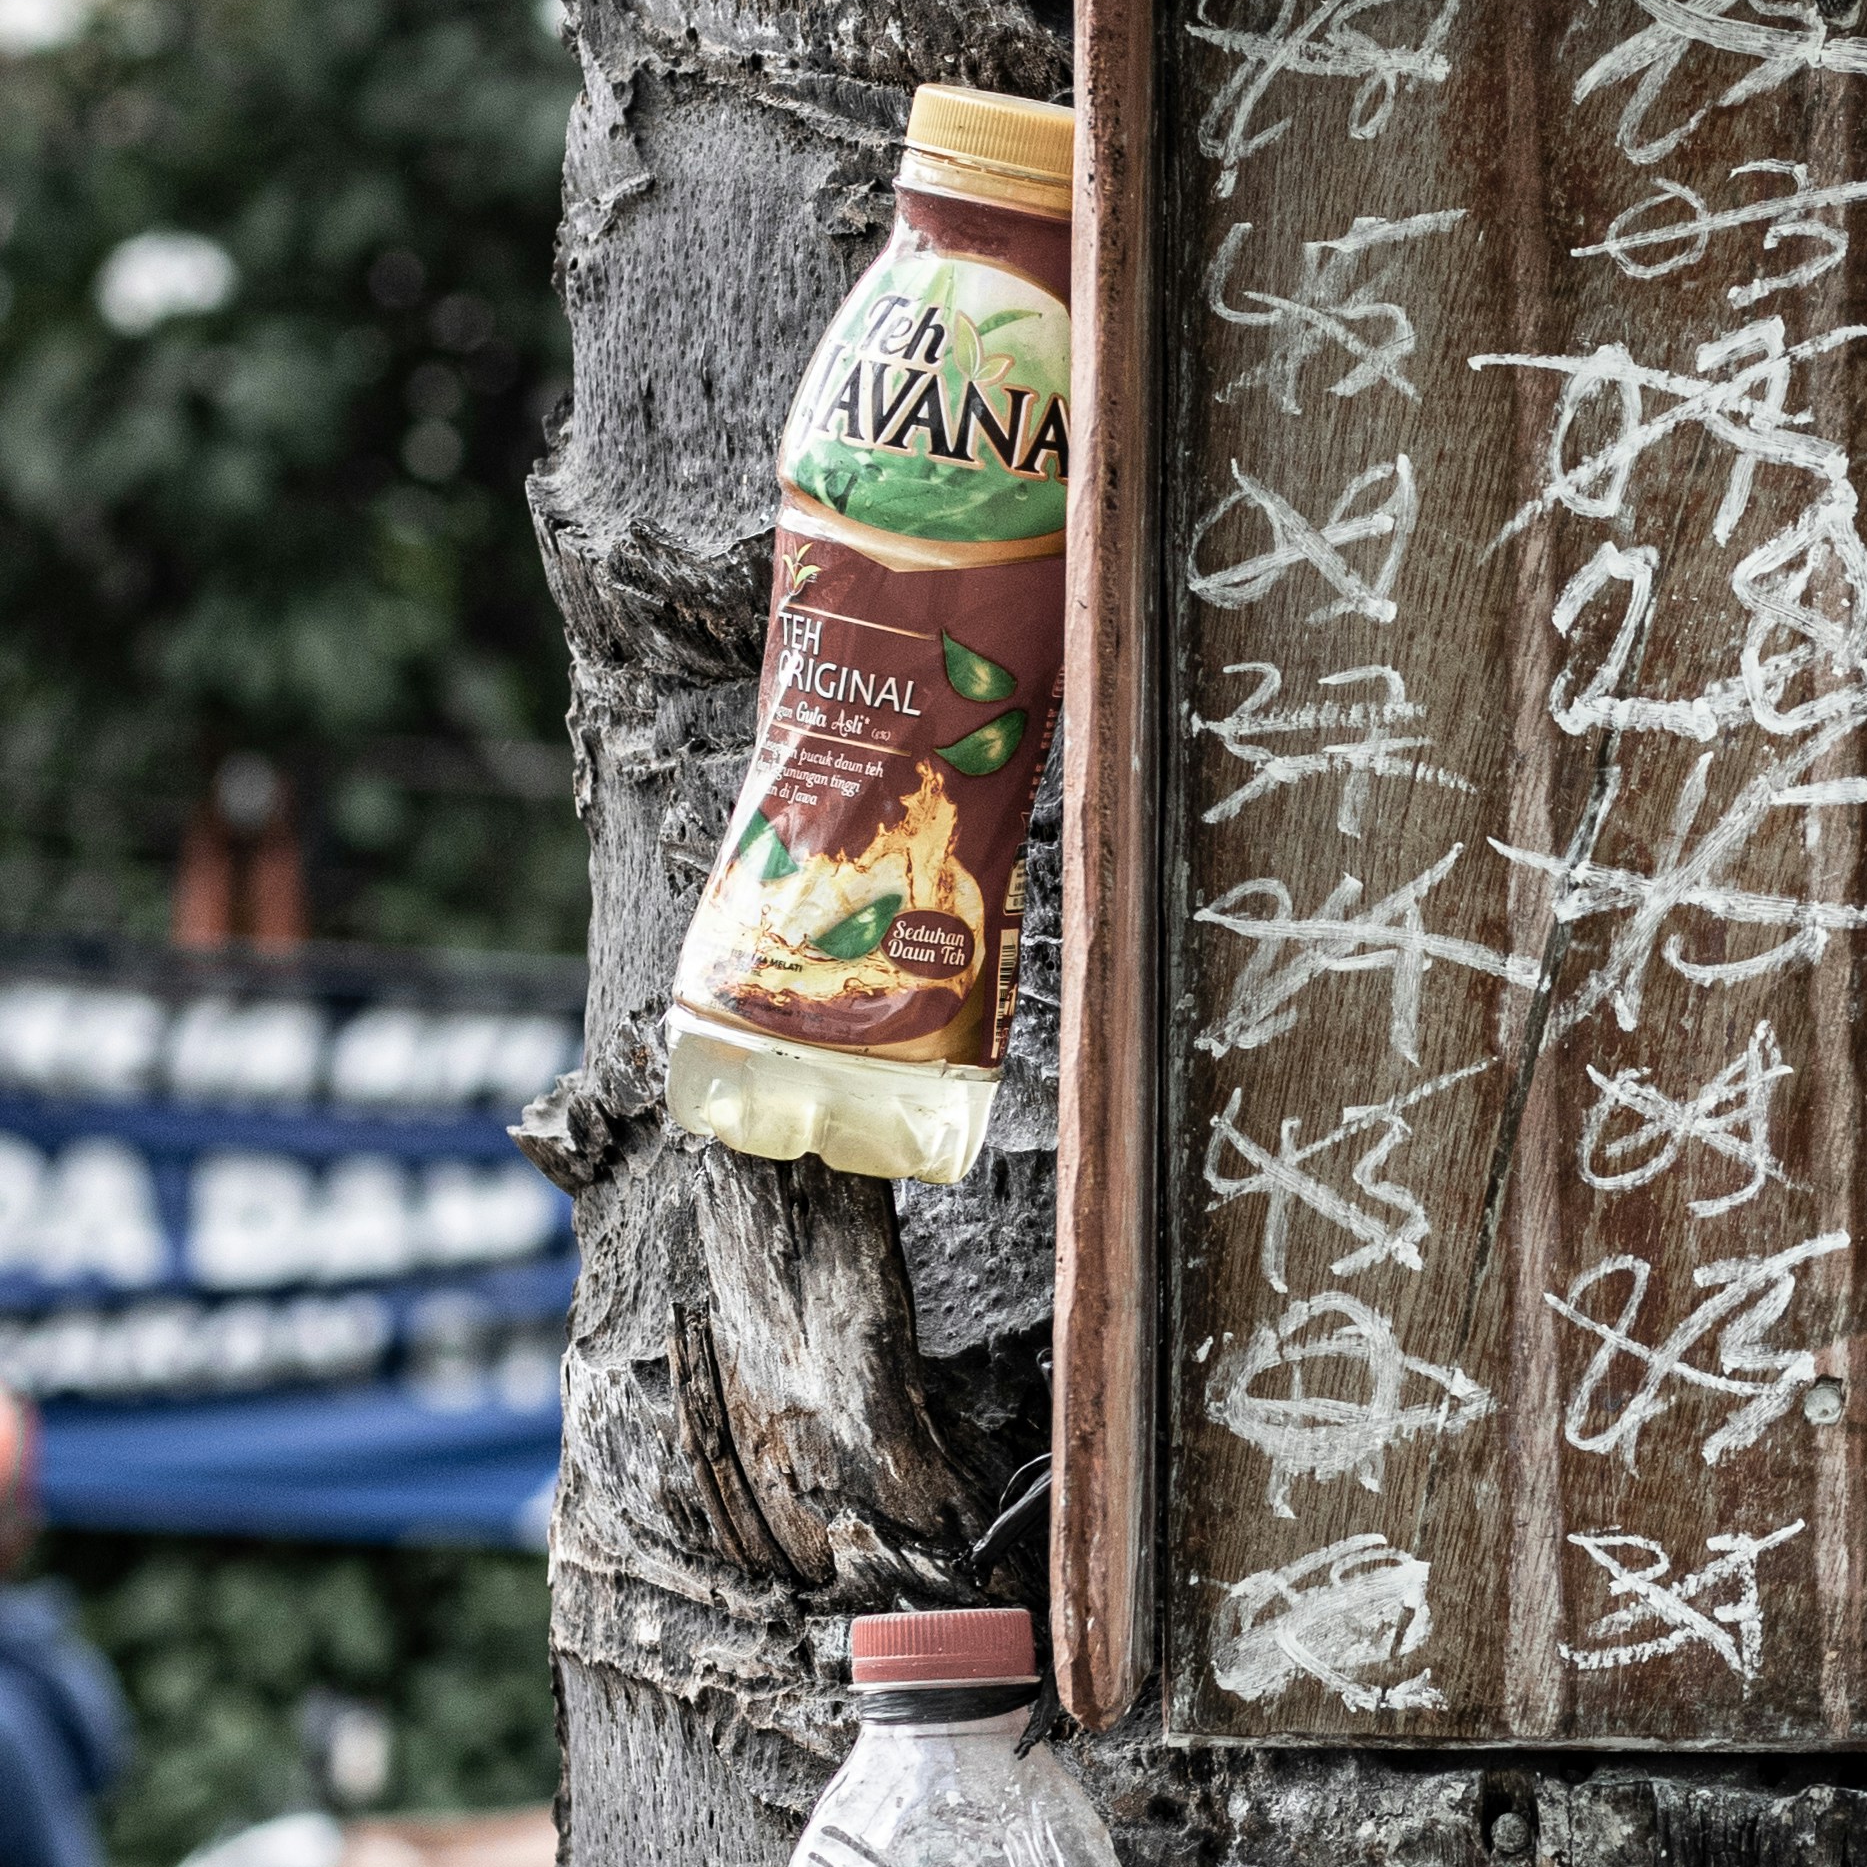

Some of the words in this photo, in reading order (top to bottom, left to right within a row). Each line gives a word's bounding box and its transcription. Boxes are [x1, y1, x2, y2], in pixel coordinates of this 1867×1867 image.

[861, 294, 947, 364] Teh
[778, 612, 823, 656] TEH
[778, 649, 922, 717] ORIGINAL
[796, 700, 827, 728] Gula
[798, 747, 833, 767] pucuk
[834, 753, 864, 774] daun
[864, 761, 884, 778] teh
[779, 783, 791, 799] di
[788, 784, 818, 806] Jawa
[830, 774, 862, 798] tinggi
[893, 920, 965, 947] Seduhan
[770, 958, 803, 973] MELATI
[888, 939, 935, 963] Daun
[941, 946, 965, 966] Teh
